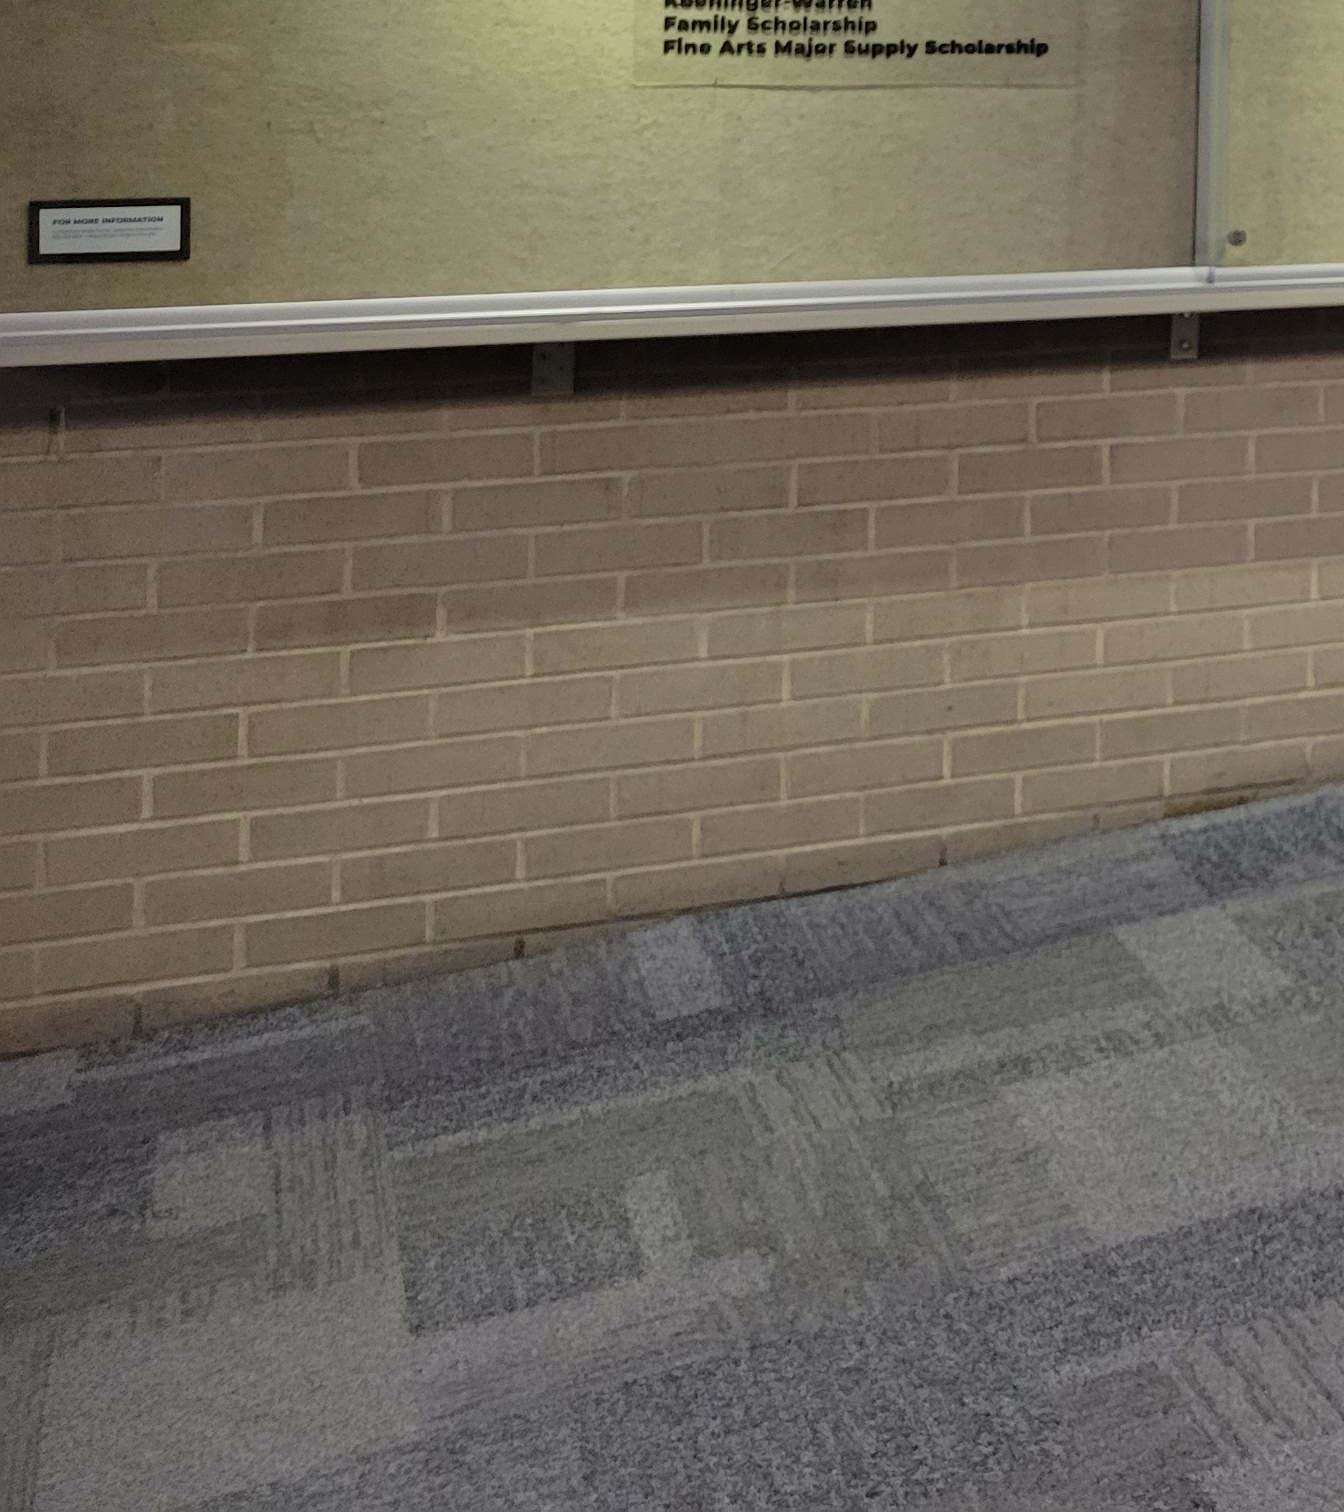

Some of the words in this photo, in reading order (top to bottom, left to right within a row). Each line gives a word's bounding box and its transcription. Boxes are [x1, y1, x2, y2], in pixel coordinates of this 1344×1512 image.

[663, 14, 741, 36] Family
[747, 15, 878, 37] Scholarship
[663, 37, 712, 56] Fine
[719, 39, 767, 57] Arts
[774, 37, 837, 62] Major
[844, 38, 918, 61] Supply
[924, 38, 1050, 58] Scholarship
[52, 218, 71, 226] FOR
[73, 217, 99, 225] MORE
[101, 215, 164, 225] INFORMATION
